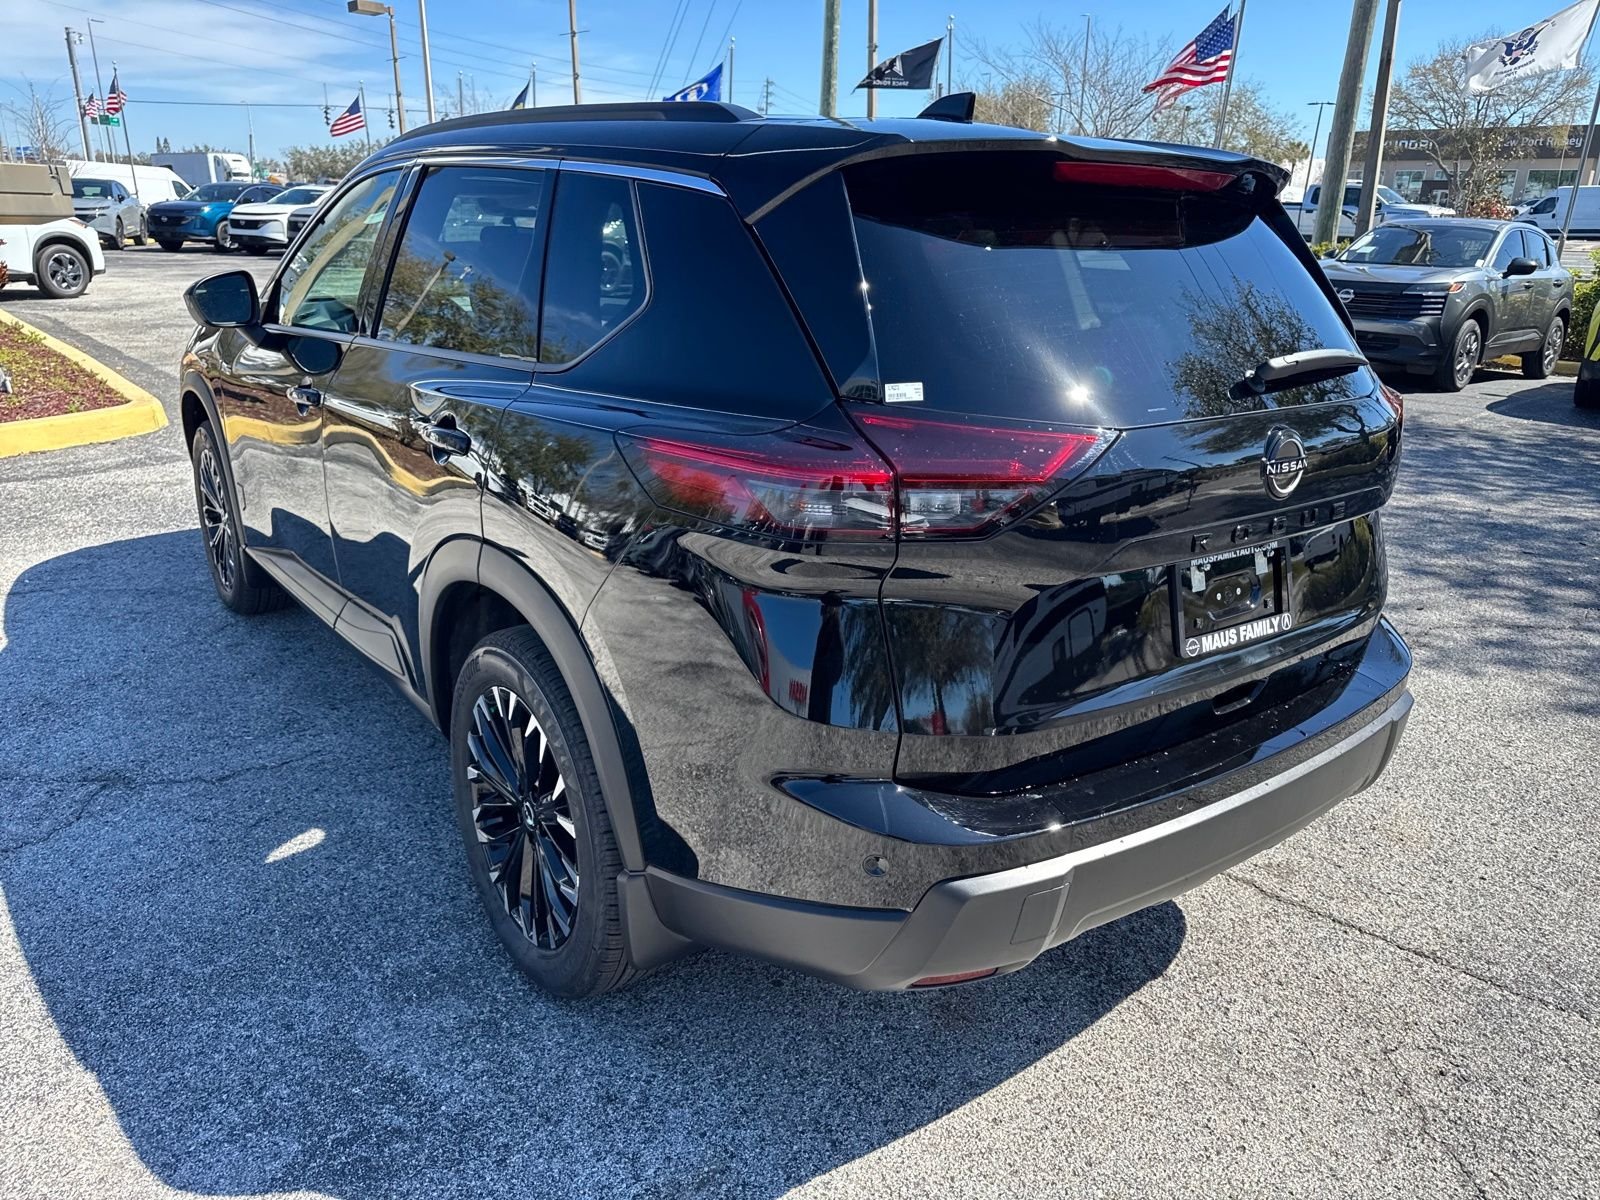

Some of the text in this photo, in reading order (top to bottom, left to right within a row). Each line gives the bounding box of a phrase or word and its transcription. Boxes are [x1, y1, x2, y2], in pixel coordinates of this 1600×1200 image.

[1521, 136, 1544, 147] Port
[1266, 459, 1308, 475] NISSAN
[1191, 501, 1346, 553] ROGUE
[1201, 617, 1279, 653] MAUS FAMILY
